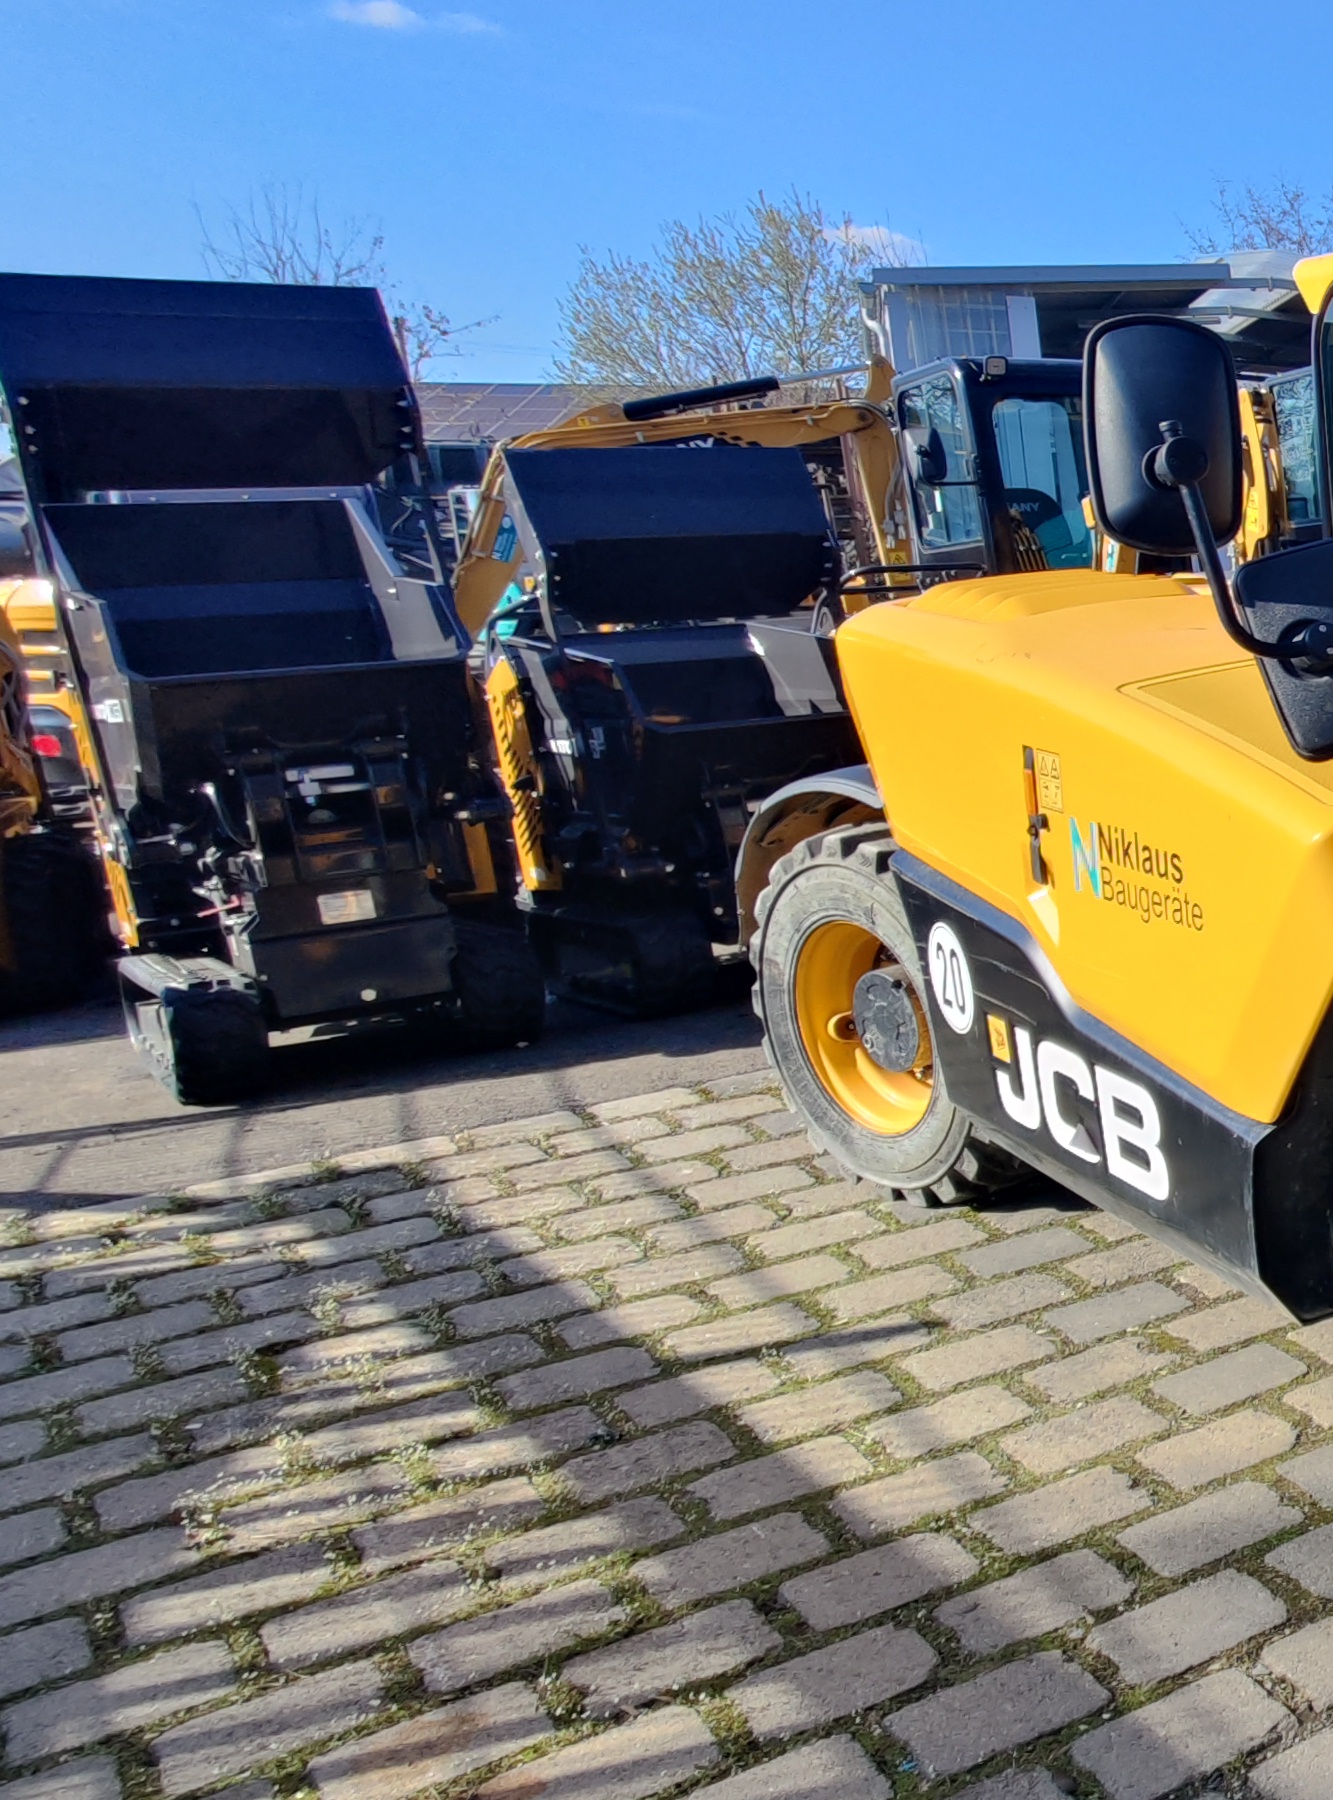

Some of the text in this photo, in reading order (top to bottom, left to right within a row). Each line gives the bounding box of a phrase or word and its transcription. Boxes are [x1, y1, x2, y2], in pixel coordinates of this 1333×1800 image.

[1097, 822, 1184, 884] Niklaus
[1101, 866, 1204, 931] Baugeräte
[935, 942, 966, 1015] 20
[996, 1024, 1170, 1201] JCB
